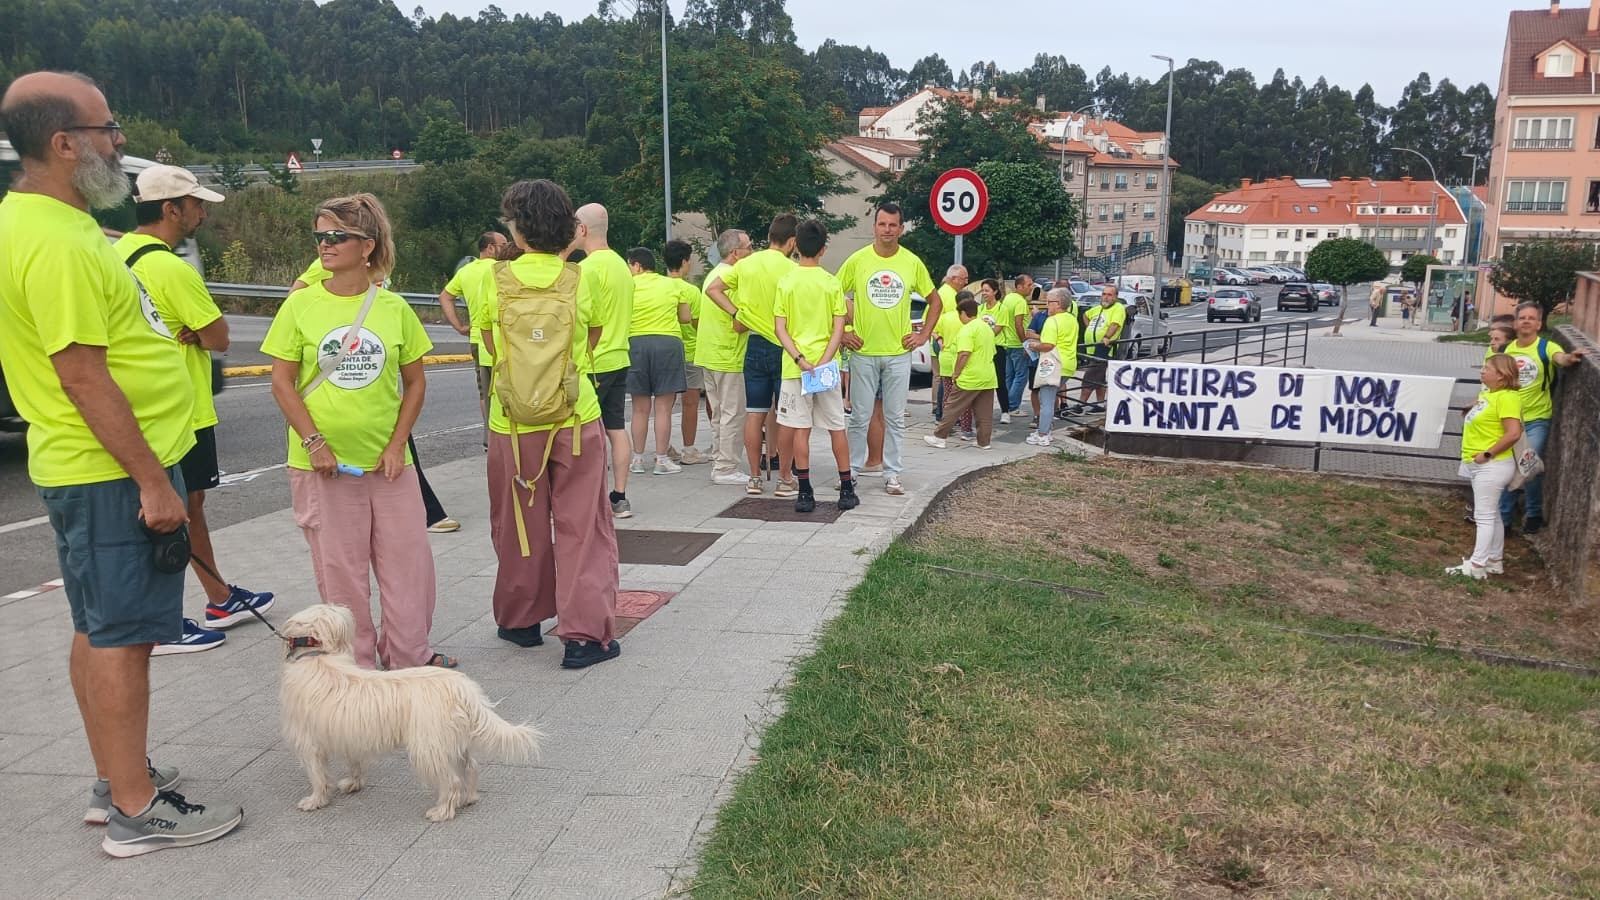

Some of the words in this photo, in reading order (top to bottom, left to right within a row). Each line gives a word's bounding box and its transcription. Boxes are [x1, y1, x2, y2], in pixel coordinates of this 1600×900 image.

[942, 191, 975, 213] 50
[1114, 364, 1257, 399] CACHEIRAS
[1279, 373, 1304, 397] DI
[1334, 375, 1401, 408] NON
[1143, 396, 1240, 431] PLANTA
[1270, 404, 1303, 430] DE
[1320, 405, 1418, 442] MIDÓN
[145, 818, 178, 831] ATOM
